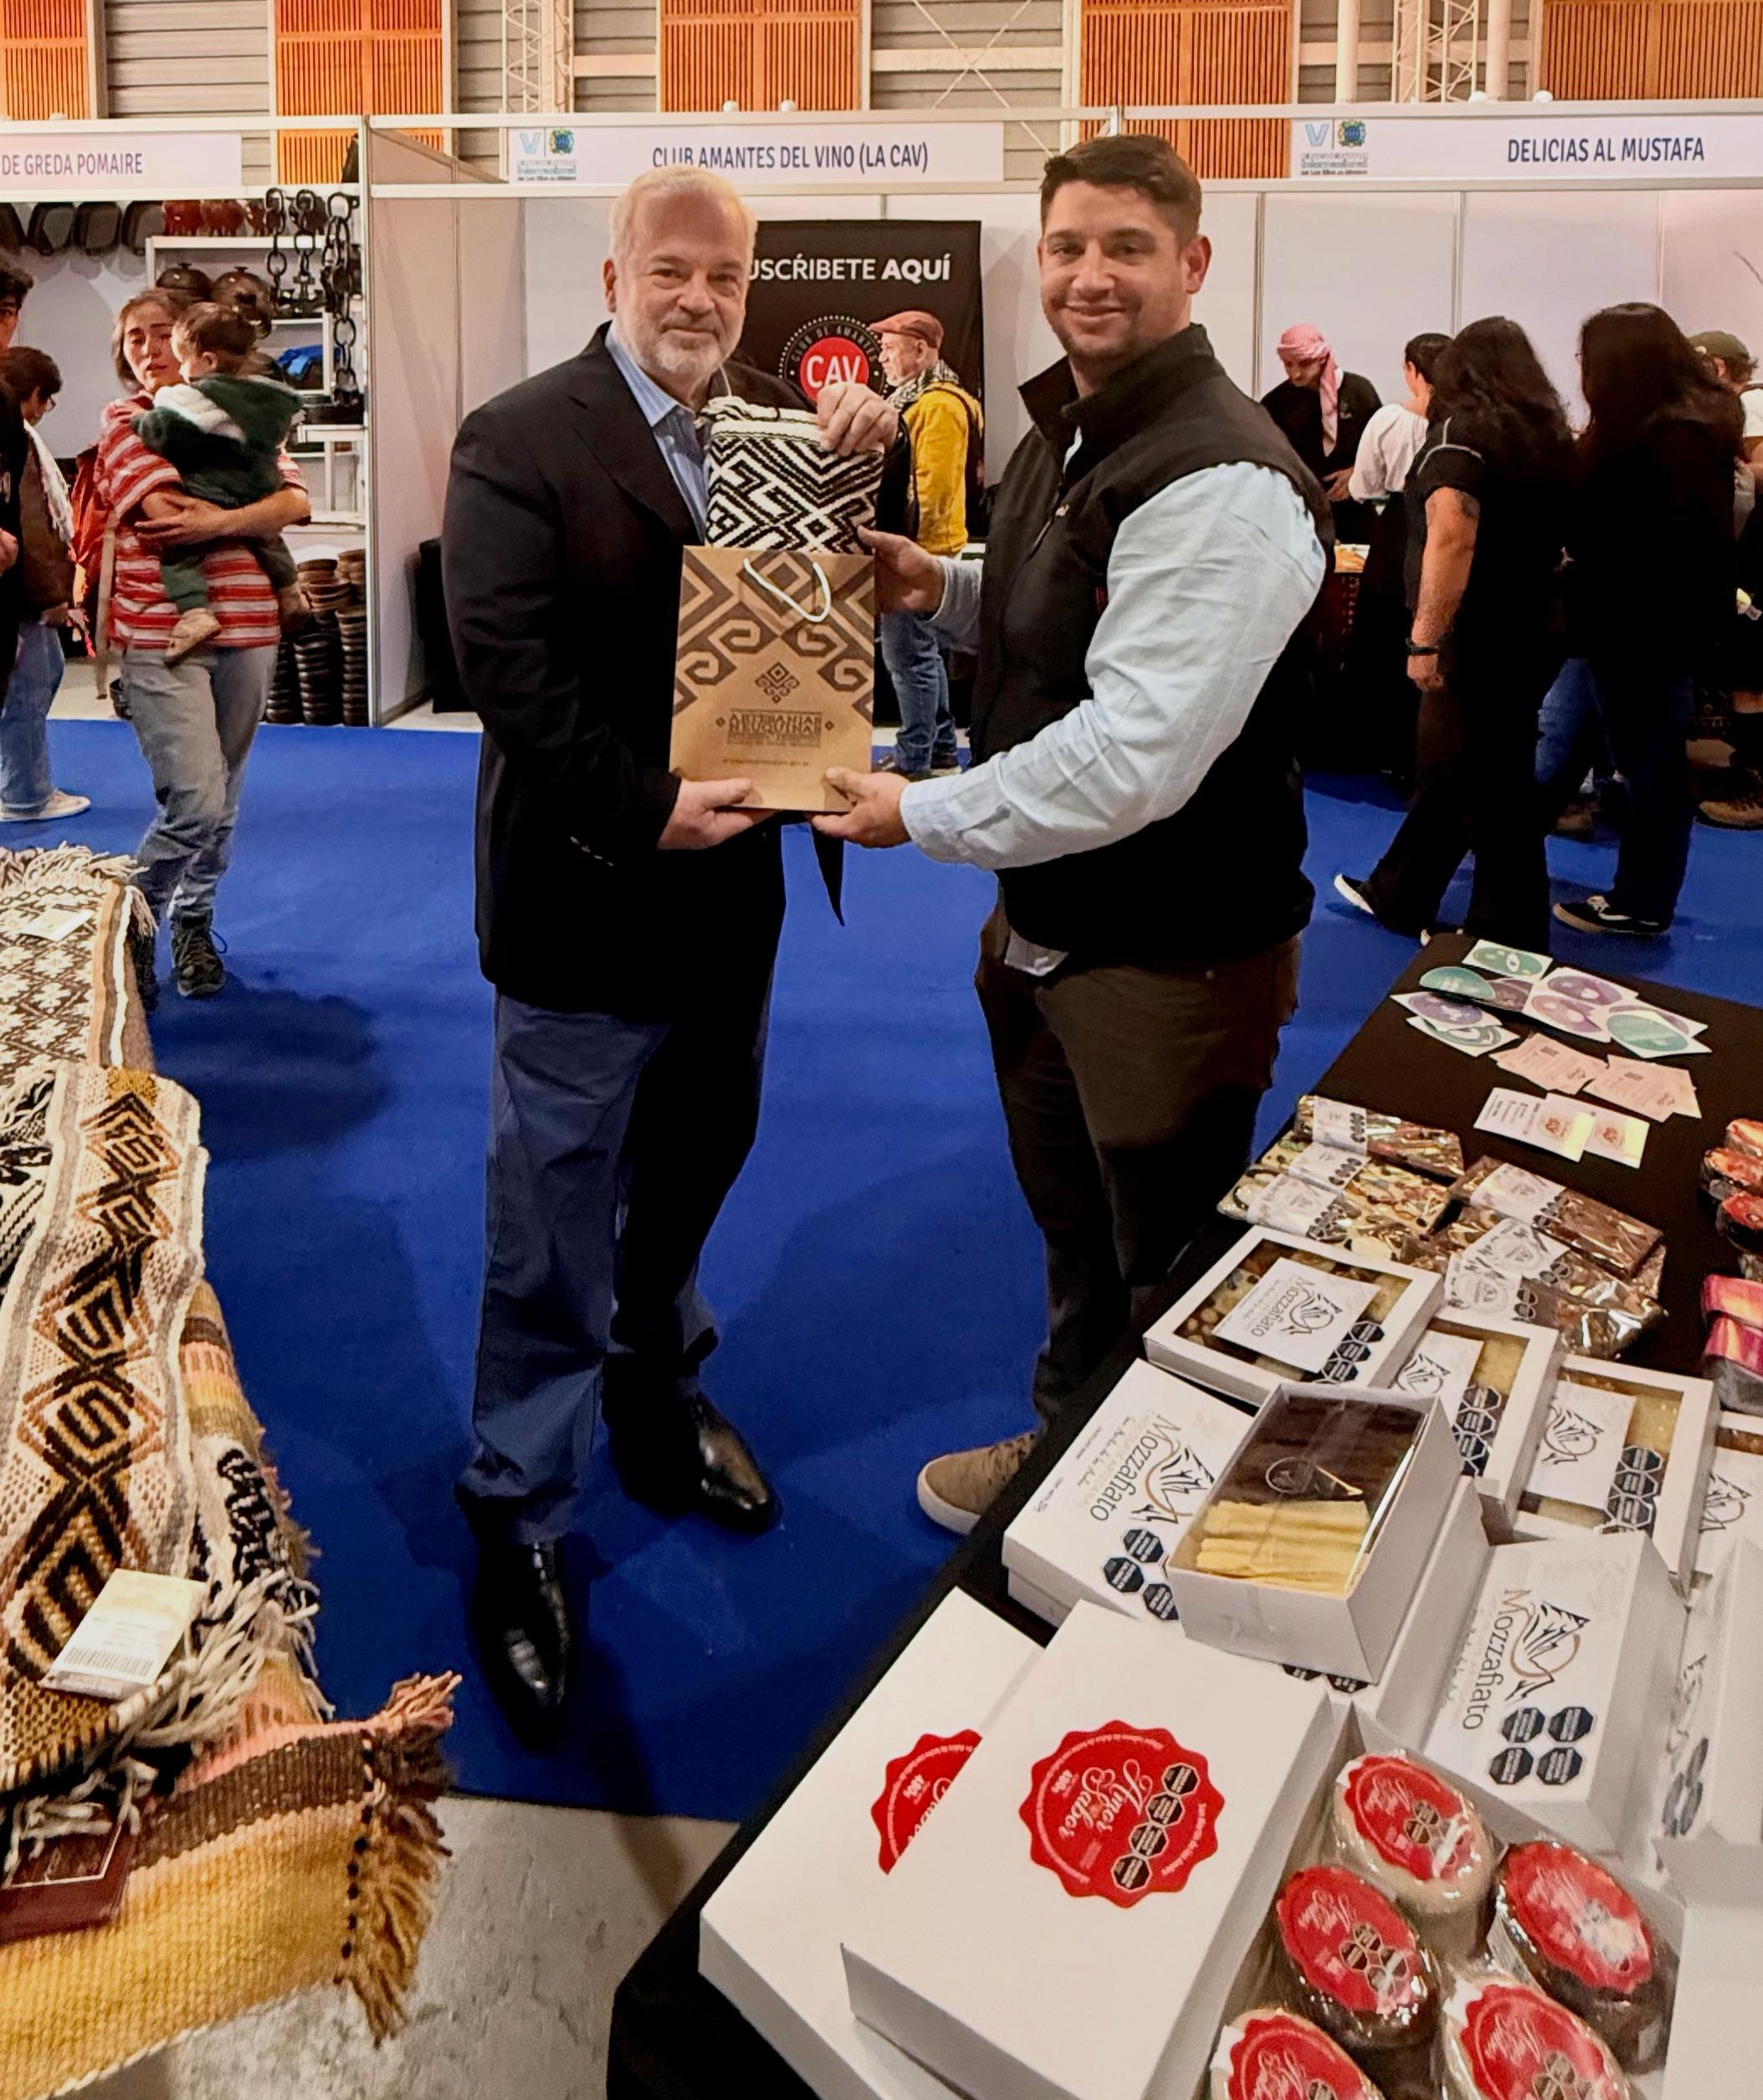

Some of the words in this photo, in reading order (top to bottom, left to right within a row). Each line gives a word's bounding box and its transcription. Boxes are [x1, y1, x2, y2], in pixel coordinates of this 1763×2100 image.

[2, 154, 20, 175] DE
[24, 154, 73, 175] GREDA
[77, 153, 143, 175] POMAIRE
[699, 146, 776, 169] AMANTES
[780, 146, 810, 168] DEL
[814, 145, 854, 168] VINO
[859, 142, 886, 174] (LA
[890, 141, 928, 173] CAV)
[1508, 138, 1590, 162] DELICIAS
[1593, 137, 1616, 161] AL
[1621, 136, 1705, 161] MUSTAFA
[881, 253, 951, 284] AQUÍ
[807, 355, 861, 389] CAV
[1090, 1414, 1181, 1522] Mozzafiato
[1462, 1589, 1531, 1730] Mozzafiato
[1058, 1766, 1116, 1839] Sabor
[1096, 1758, 1154, 1835] Amor
